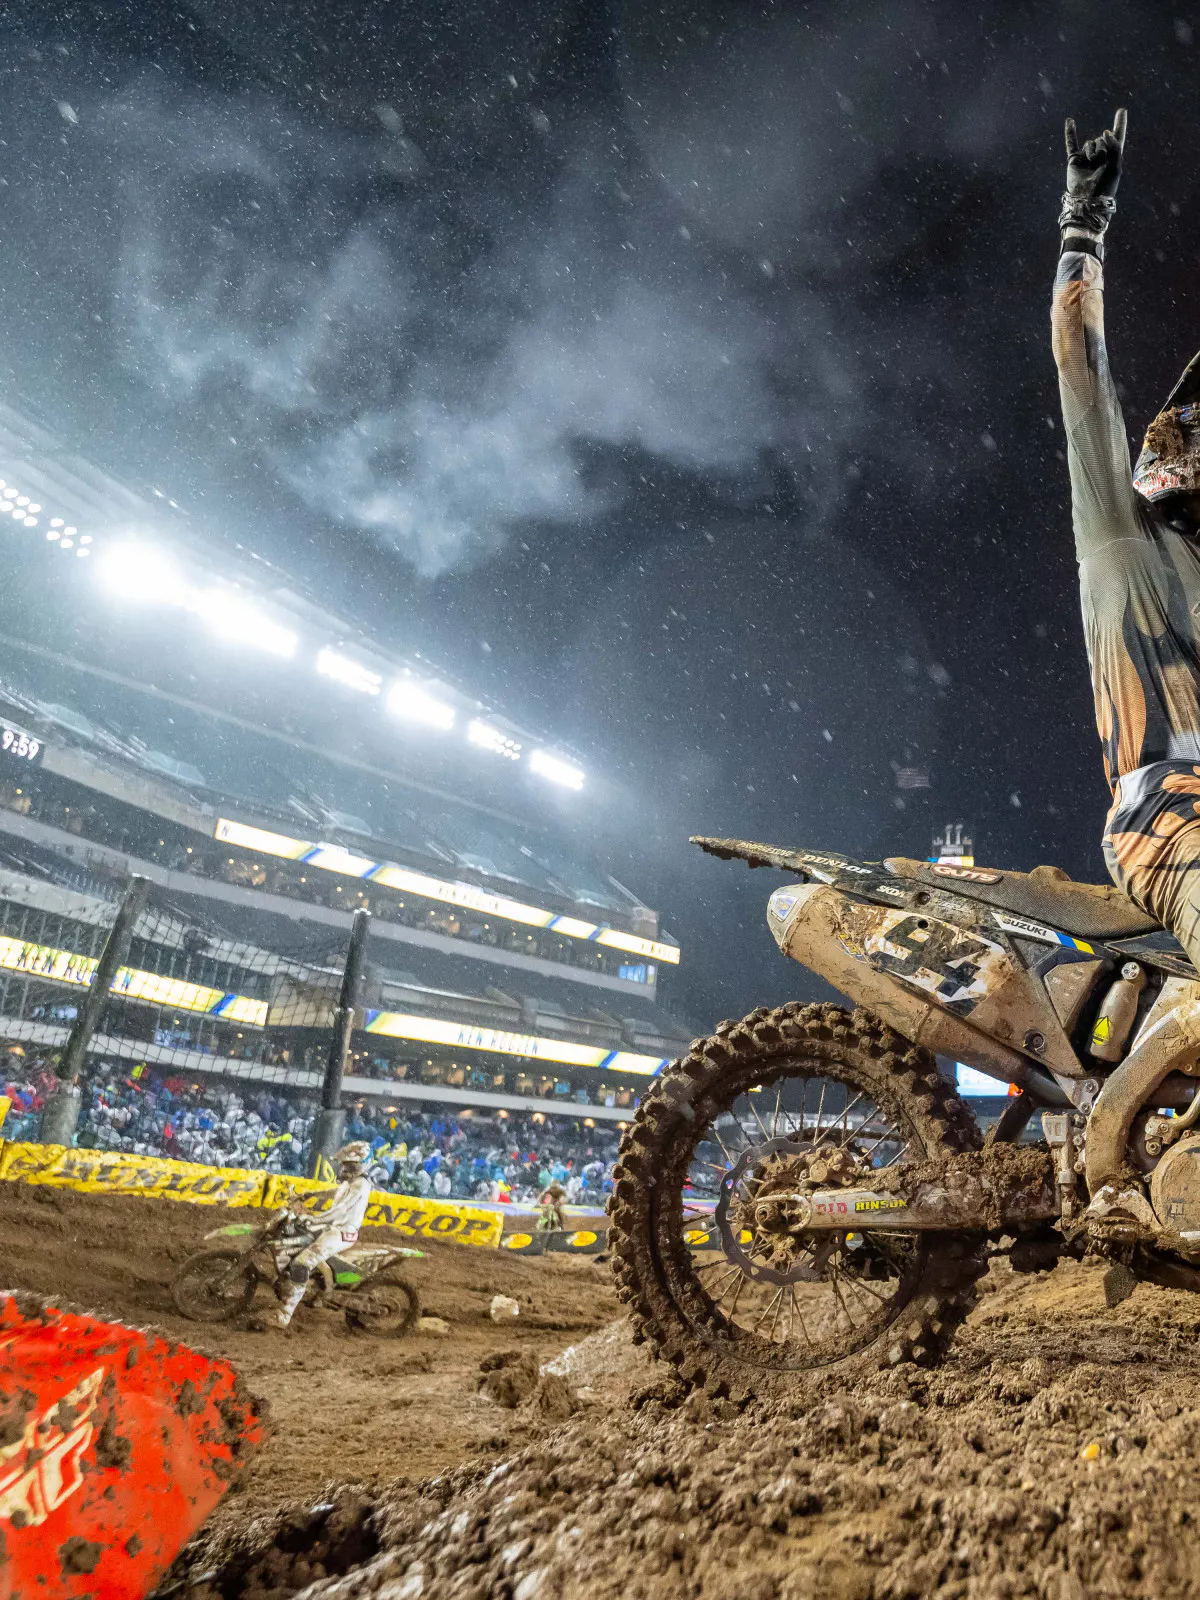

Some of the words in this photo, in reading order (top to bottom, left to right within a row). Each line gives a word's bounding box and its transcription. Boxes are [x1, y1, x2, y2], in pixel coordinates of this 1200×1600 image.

[2, 730, 40, 760] 9:59
[799, 854, 873, 874] DUNLOP
[934, 866, 999, 882] GUTS
[1001, 914, 1048, 937] SUZUKI
[63, 954, 134, 992] ROEN
[855, 1199, 908, 1211] HINSON
